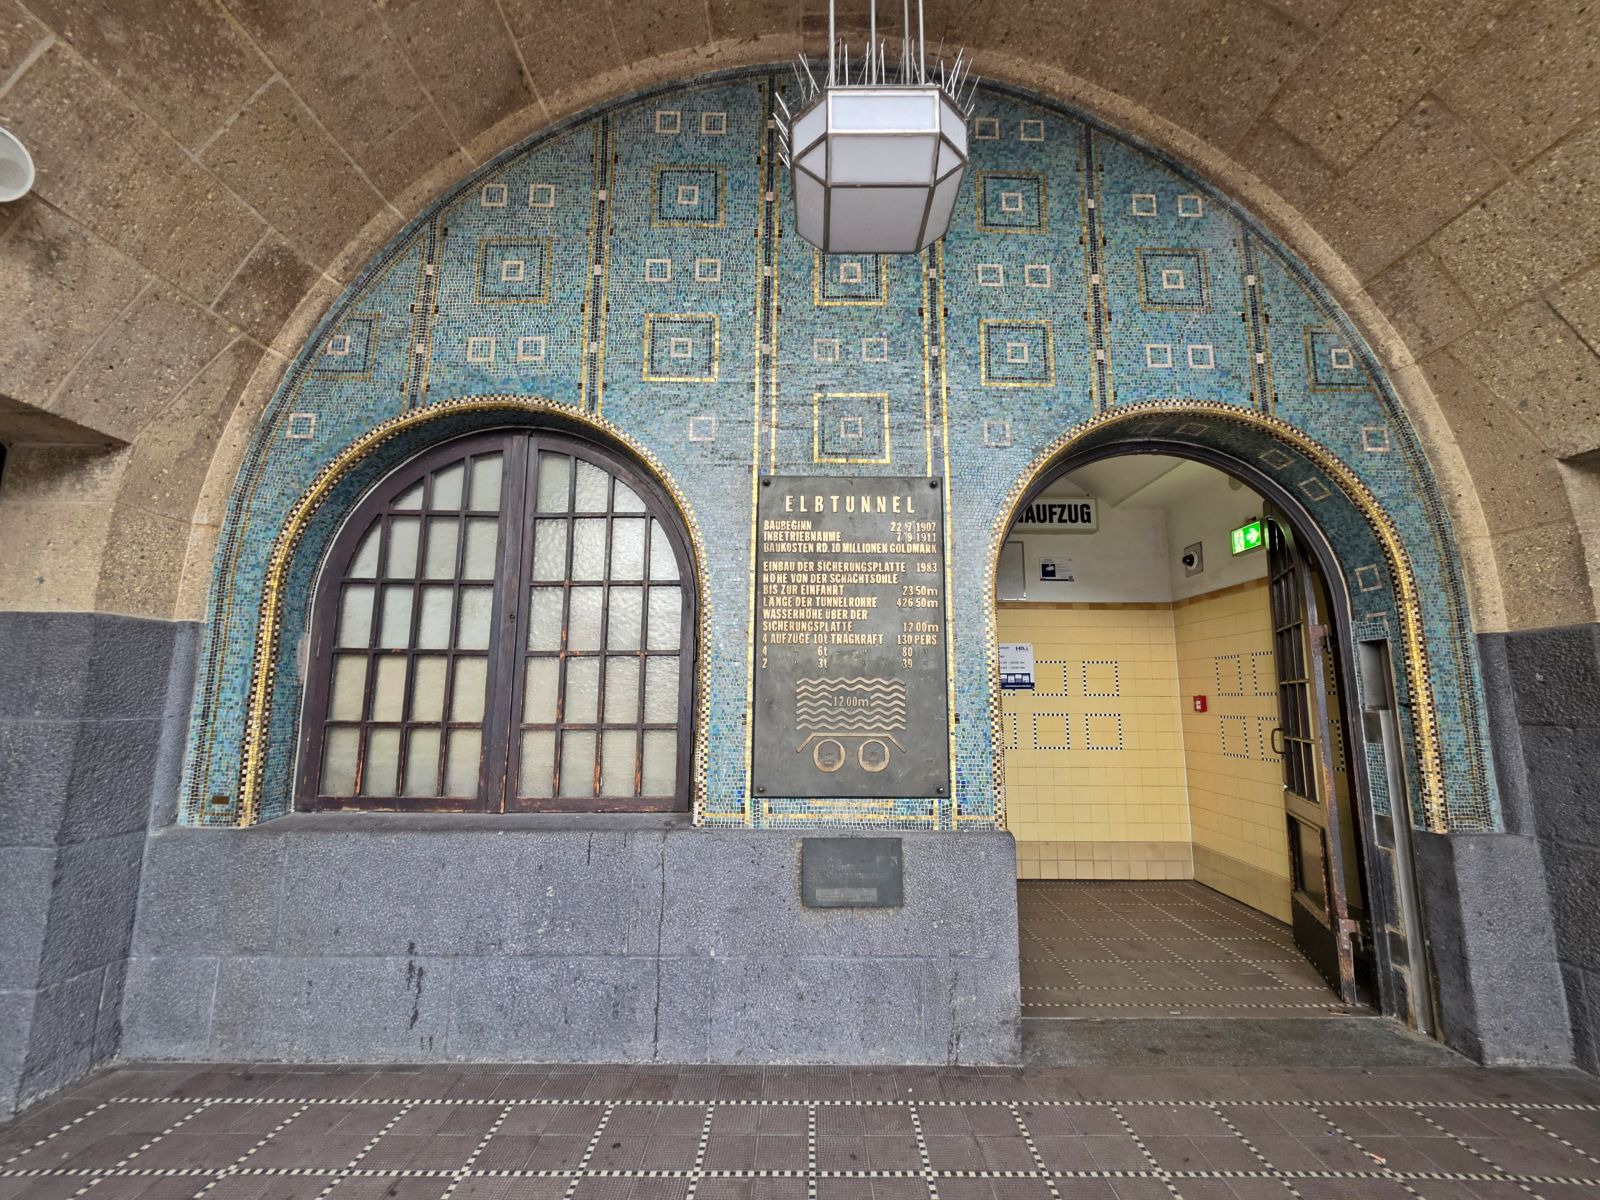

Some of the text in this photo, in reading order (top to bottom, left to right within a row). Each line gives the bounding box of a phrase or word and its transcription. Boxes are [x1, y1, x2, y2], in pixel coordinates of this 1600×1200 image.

[785, 495, 915, 513] ELBTUNNEL
[1018, 504, 1091, 523] AUFZUG
[764, 520, 812, 531] BAUBEGINN
[764, 531, 841, 541] INBETRIEBNAHME
[764, 542, 937, 554] BAUKOSTEN RD. 10 MILLIONEN GOLDMARK
[763, 561, 937, 573] EINBAU DER SICHERUNGSPLATTE 1983
[791, 573, 808, 583] VON
[810, 574, 828, 583] DER
[830, 574, 899, 584] SCHACHTSOHLE
[763, 585, 778, 595] BIS
[780, 585, 798, 595] ZUR
[801, 585, 844, 595] EINFAHRT
[795, 597, 812, 607] DER
[763, 608, 868, 620] WASSERHÖHE ÜBER DER
[763, 621, 852, 632] SICHERUNGSPLATTE
[763, 634, 767, 643] 4
[813, 634, 828, 644] 10t
[831, 634, 884, 645] TRAGKRAFT
[897, 634, 913, 645] 130
[762, 646, 913, 657] 4 6t 80
[762, 657, 913, 669] 2 3t 39
